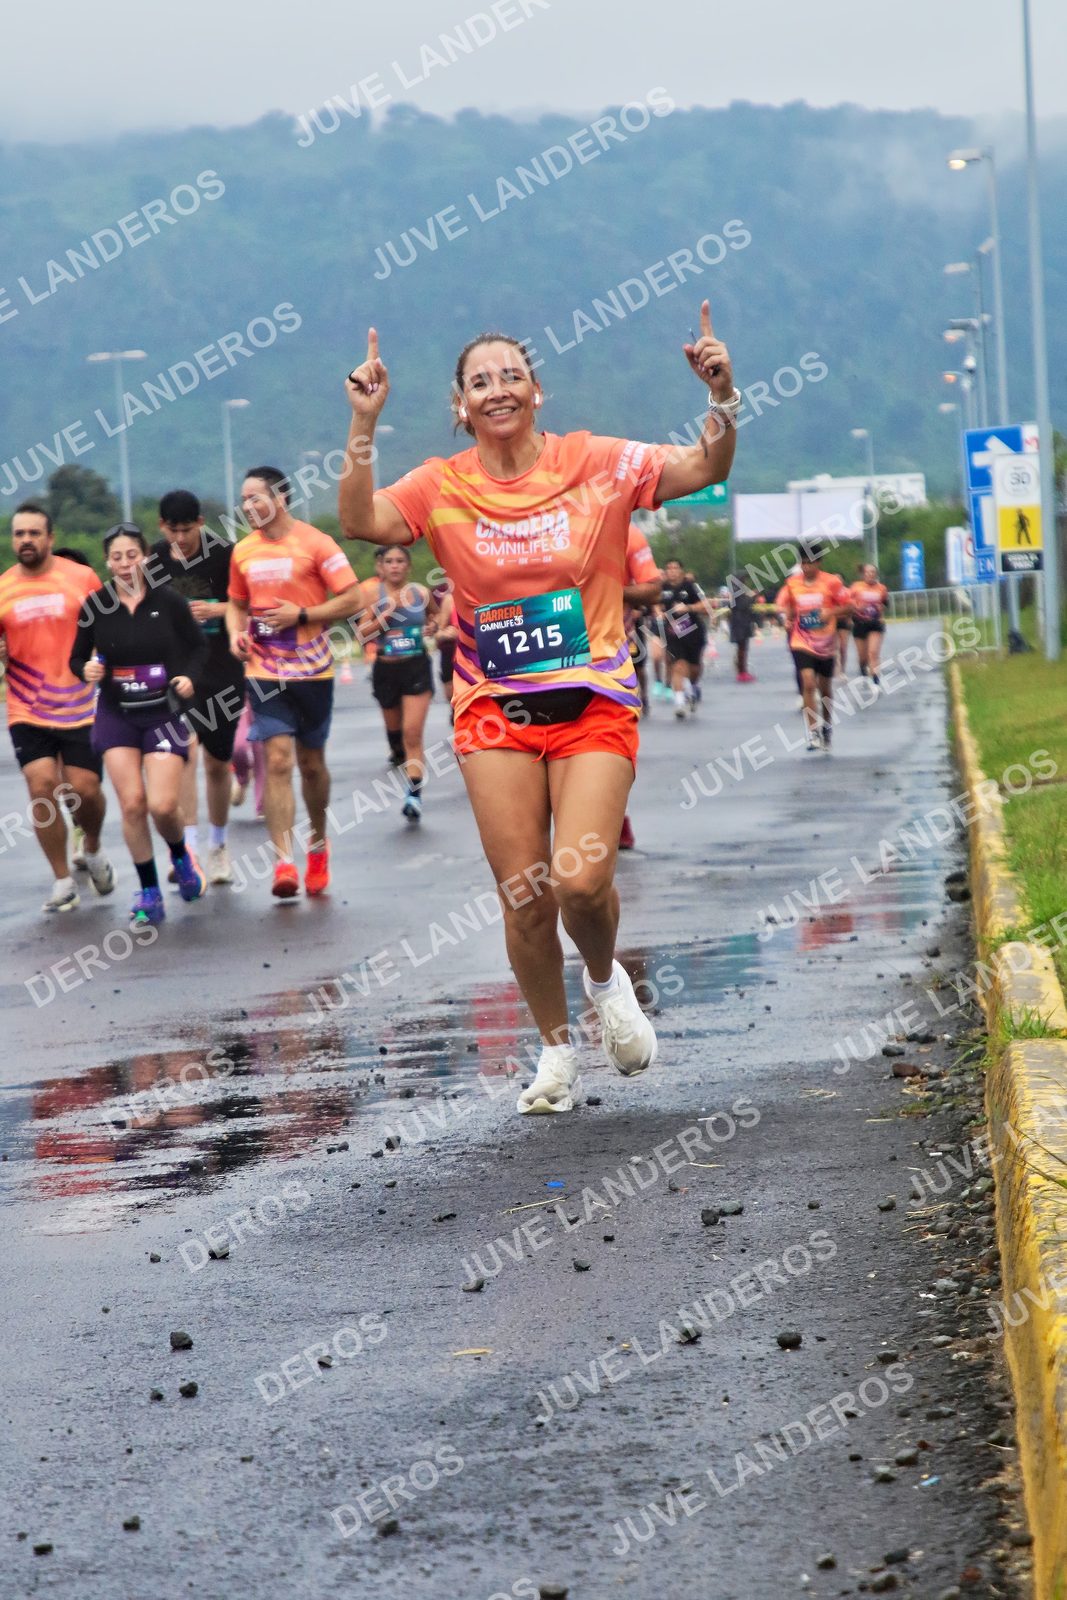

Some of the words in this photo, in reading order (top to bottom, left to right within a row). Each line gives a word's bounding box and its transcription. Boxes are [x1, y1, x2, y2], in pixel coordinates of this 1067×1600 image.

[1009, 471, 1031, 486] 30
[475, 511, 569, 539] CARRERA
[551, 594, 573, 613] 10K
[480, 605, 523, 623] CARRERA
[497, 624, 563, 655] 1215
